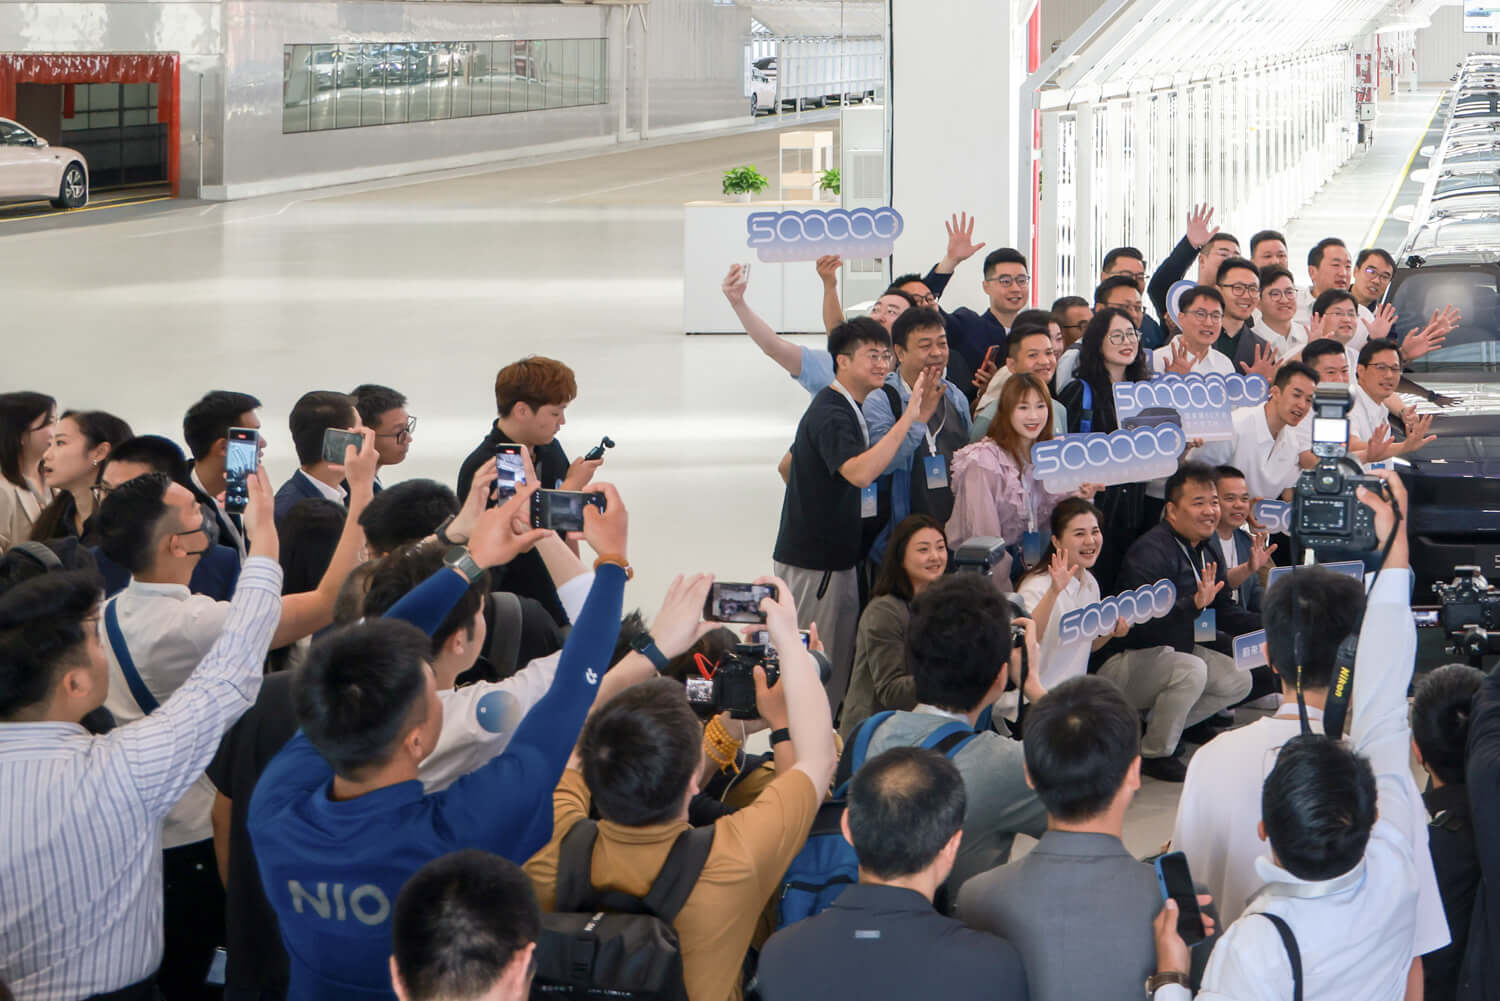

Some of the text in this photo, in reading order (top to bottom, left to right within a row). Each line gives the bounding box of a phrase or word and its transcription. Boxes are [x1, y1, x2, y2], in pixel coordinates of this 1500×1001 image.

[751, 212, 899, 243] 500000
[1036, 427, 1182, 475] 500000
[1335, 665, 1350, 698] Nikon
[287, 879, 391, 926] NIO
